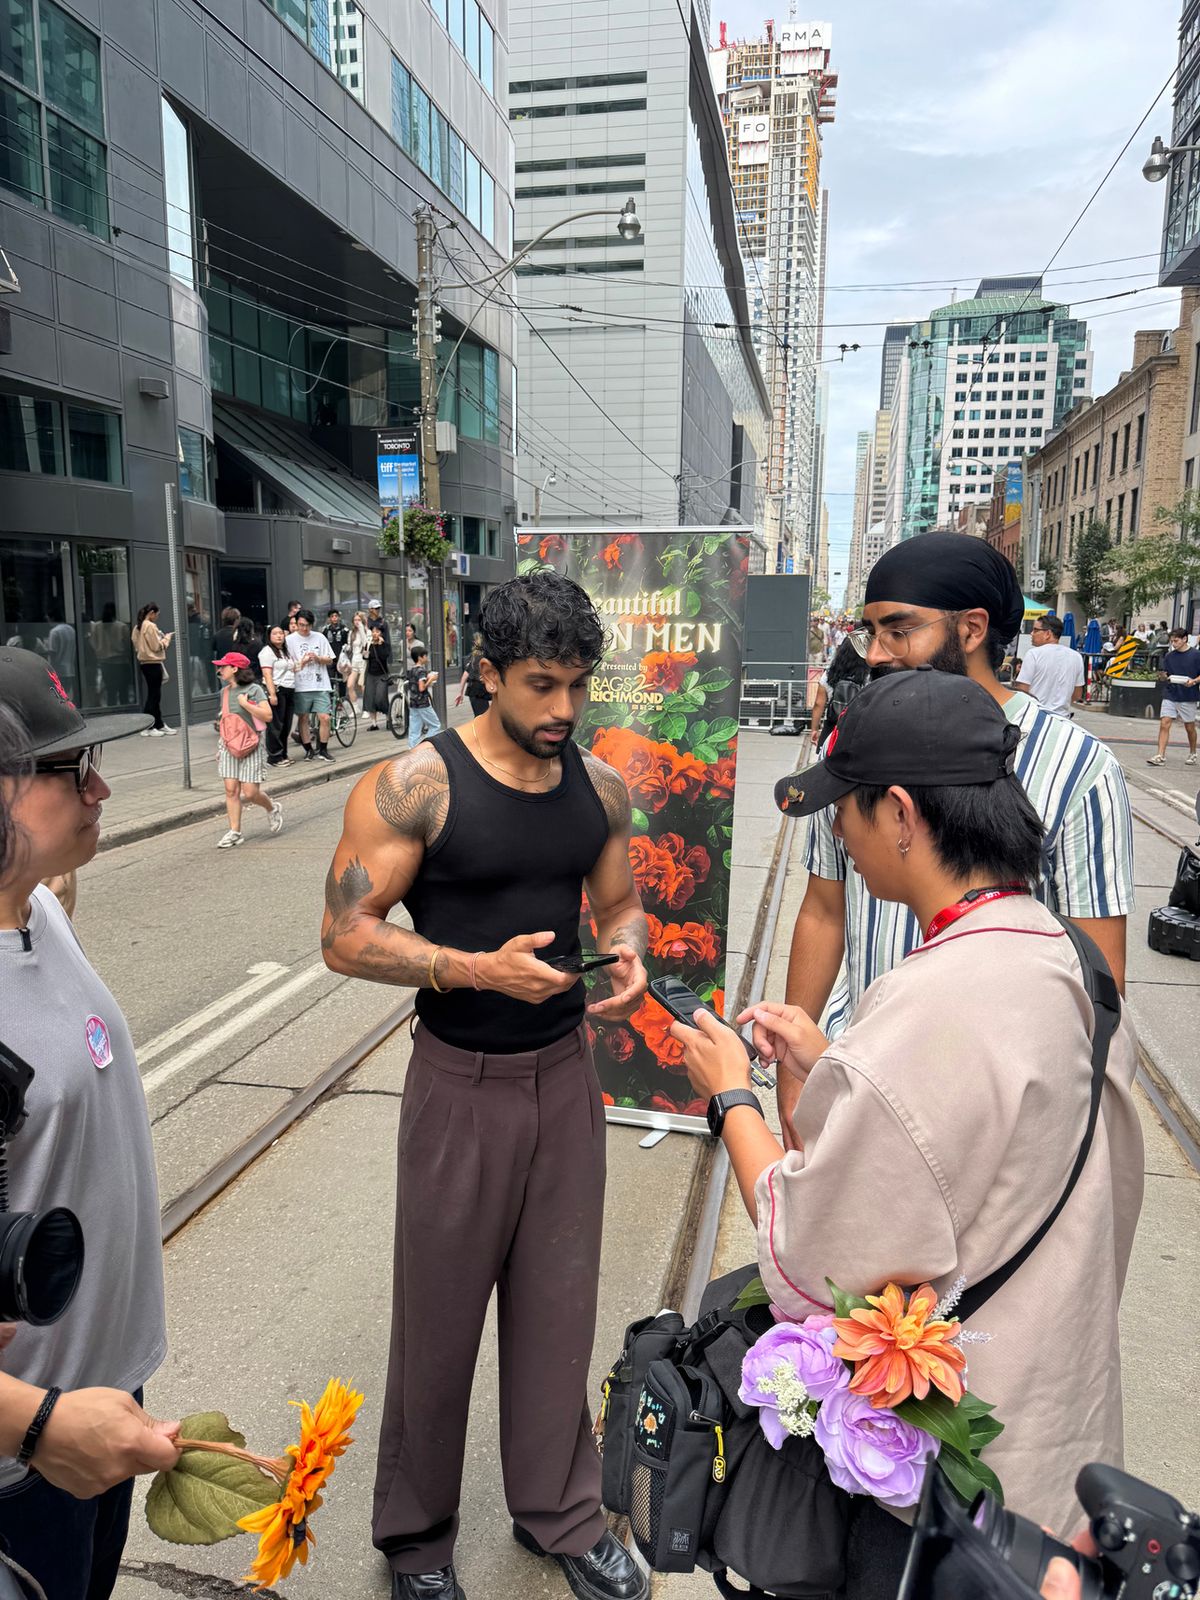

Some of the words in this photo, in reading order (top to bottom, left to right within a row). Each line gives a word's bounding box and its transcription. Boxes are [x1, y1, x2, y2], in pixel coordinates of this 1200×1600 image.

[384, 442, 411, 450] TORONTO
[380, 462, 393, 473] tiff
[1031, 579, 1044, 589] 40
[594, 590, 682, 616] eautiful
[645, 623, 722, 653] MEN
[600, 661, 637, 672] Presented
[639, 661, 648, 673] by
[590, 690, 664, 704] RICHMOND
